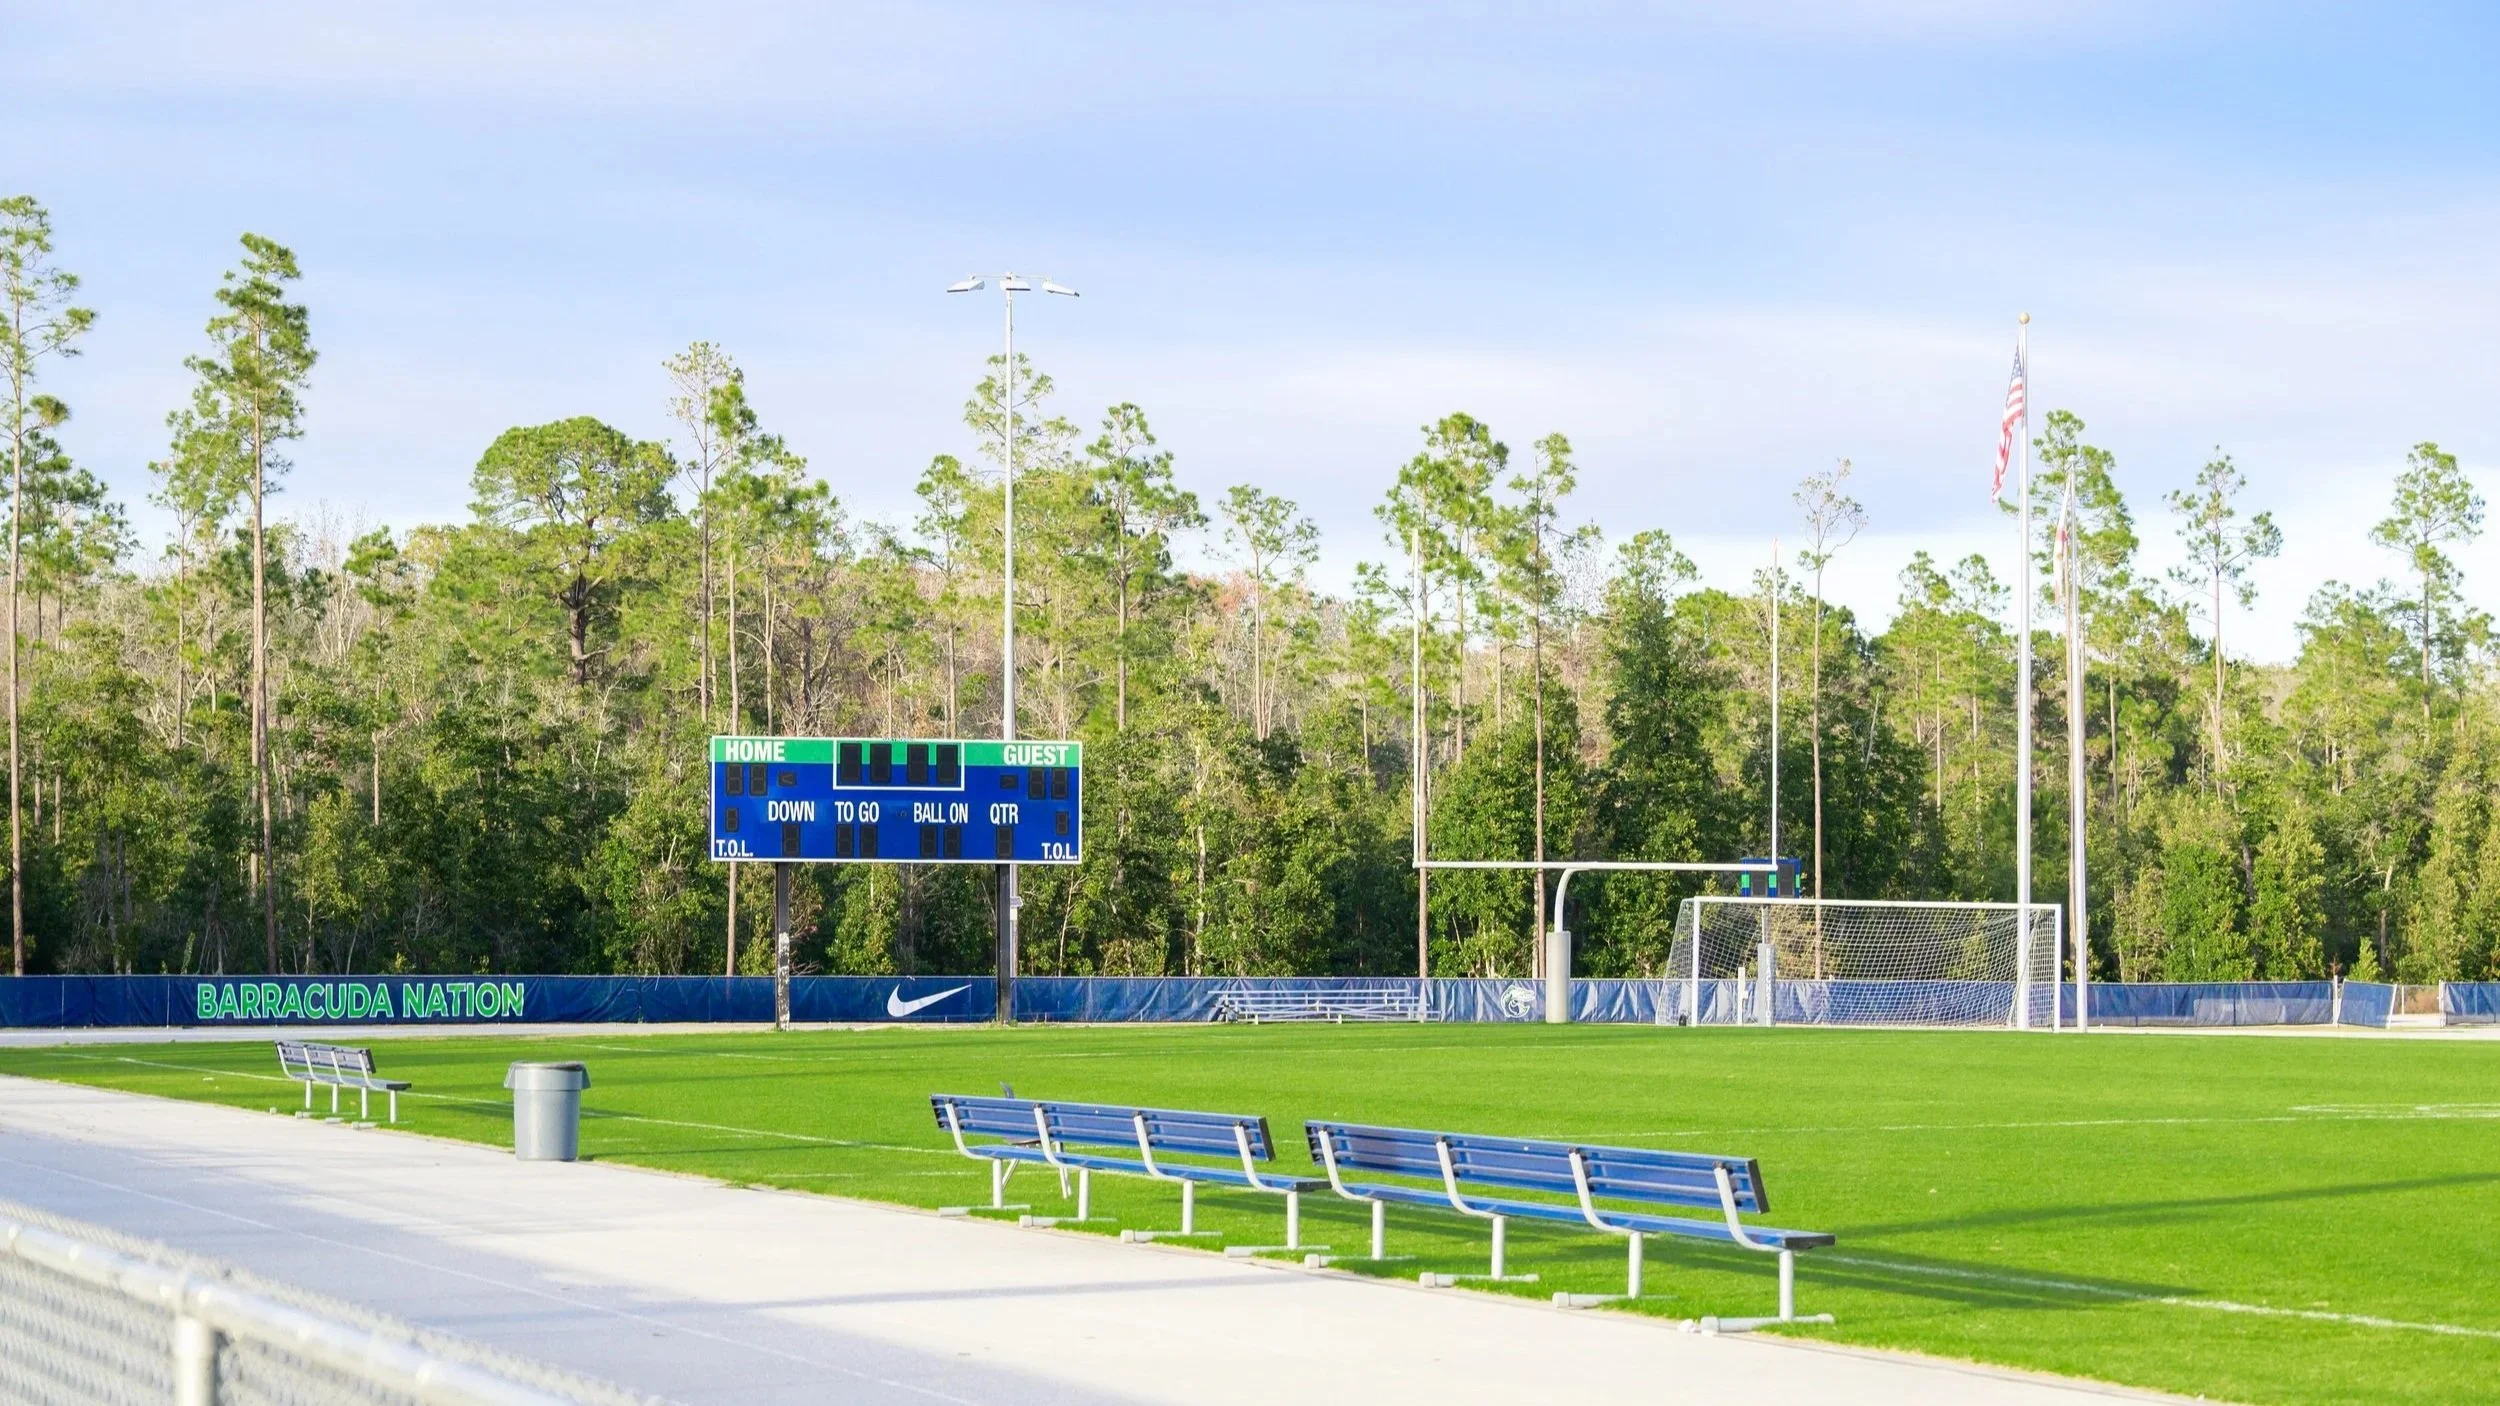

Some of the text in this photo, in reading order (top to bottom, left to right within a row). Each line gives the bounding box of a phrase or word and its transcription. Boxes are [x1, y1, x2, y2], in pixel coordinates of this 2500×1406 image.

[724, 741, 785, 762] HOME
[1003, 745, 1068, 766] GUEST
[768, 800, 815, 822] DOWN
[834, 801, 880, 823] TO GO
[913, 802, 969, 824] BALL ON
[989, 803, 1019, 825] QTR
[715, 839, 754, 858] T.O.L.
[1041, 842, 1078, 861] T.O.L.
[198, 983, 524, 1019] BARRACUDA NATION
